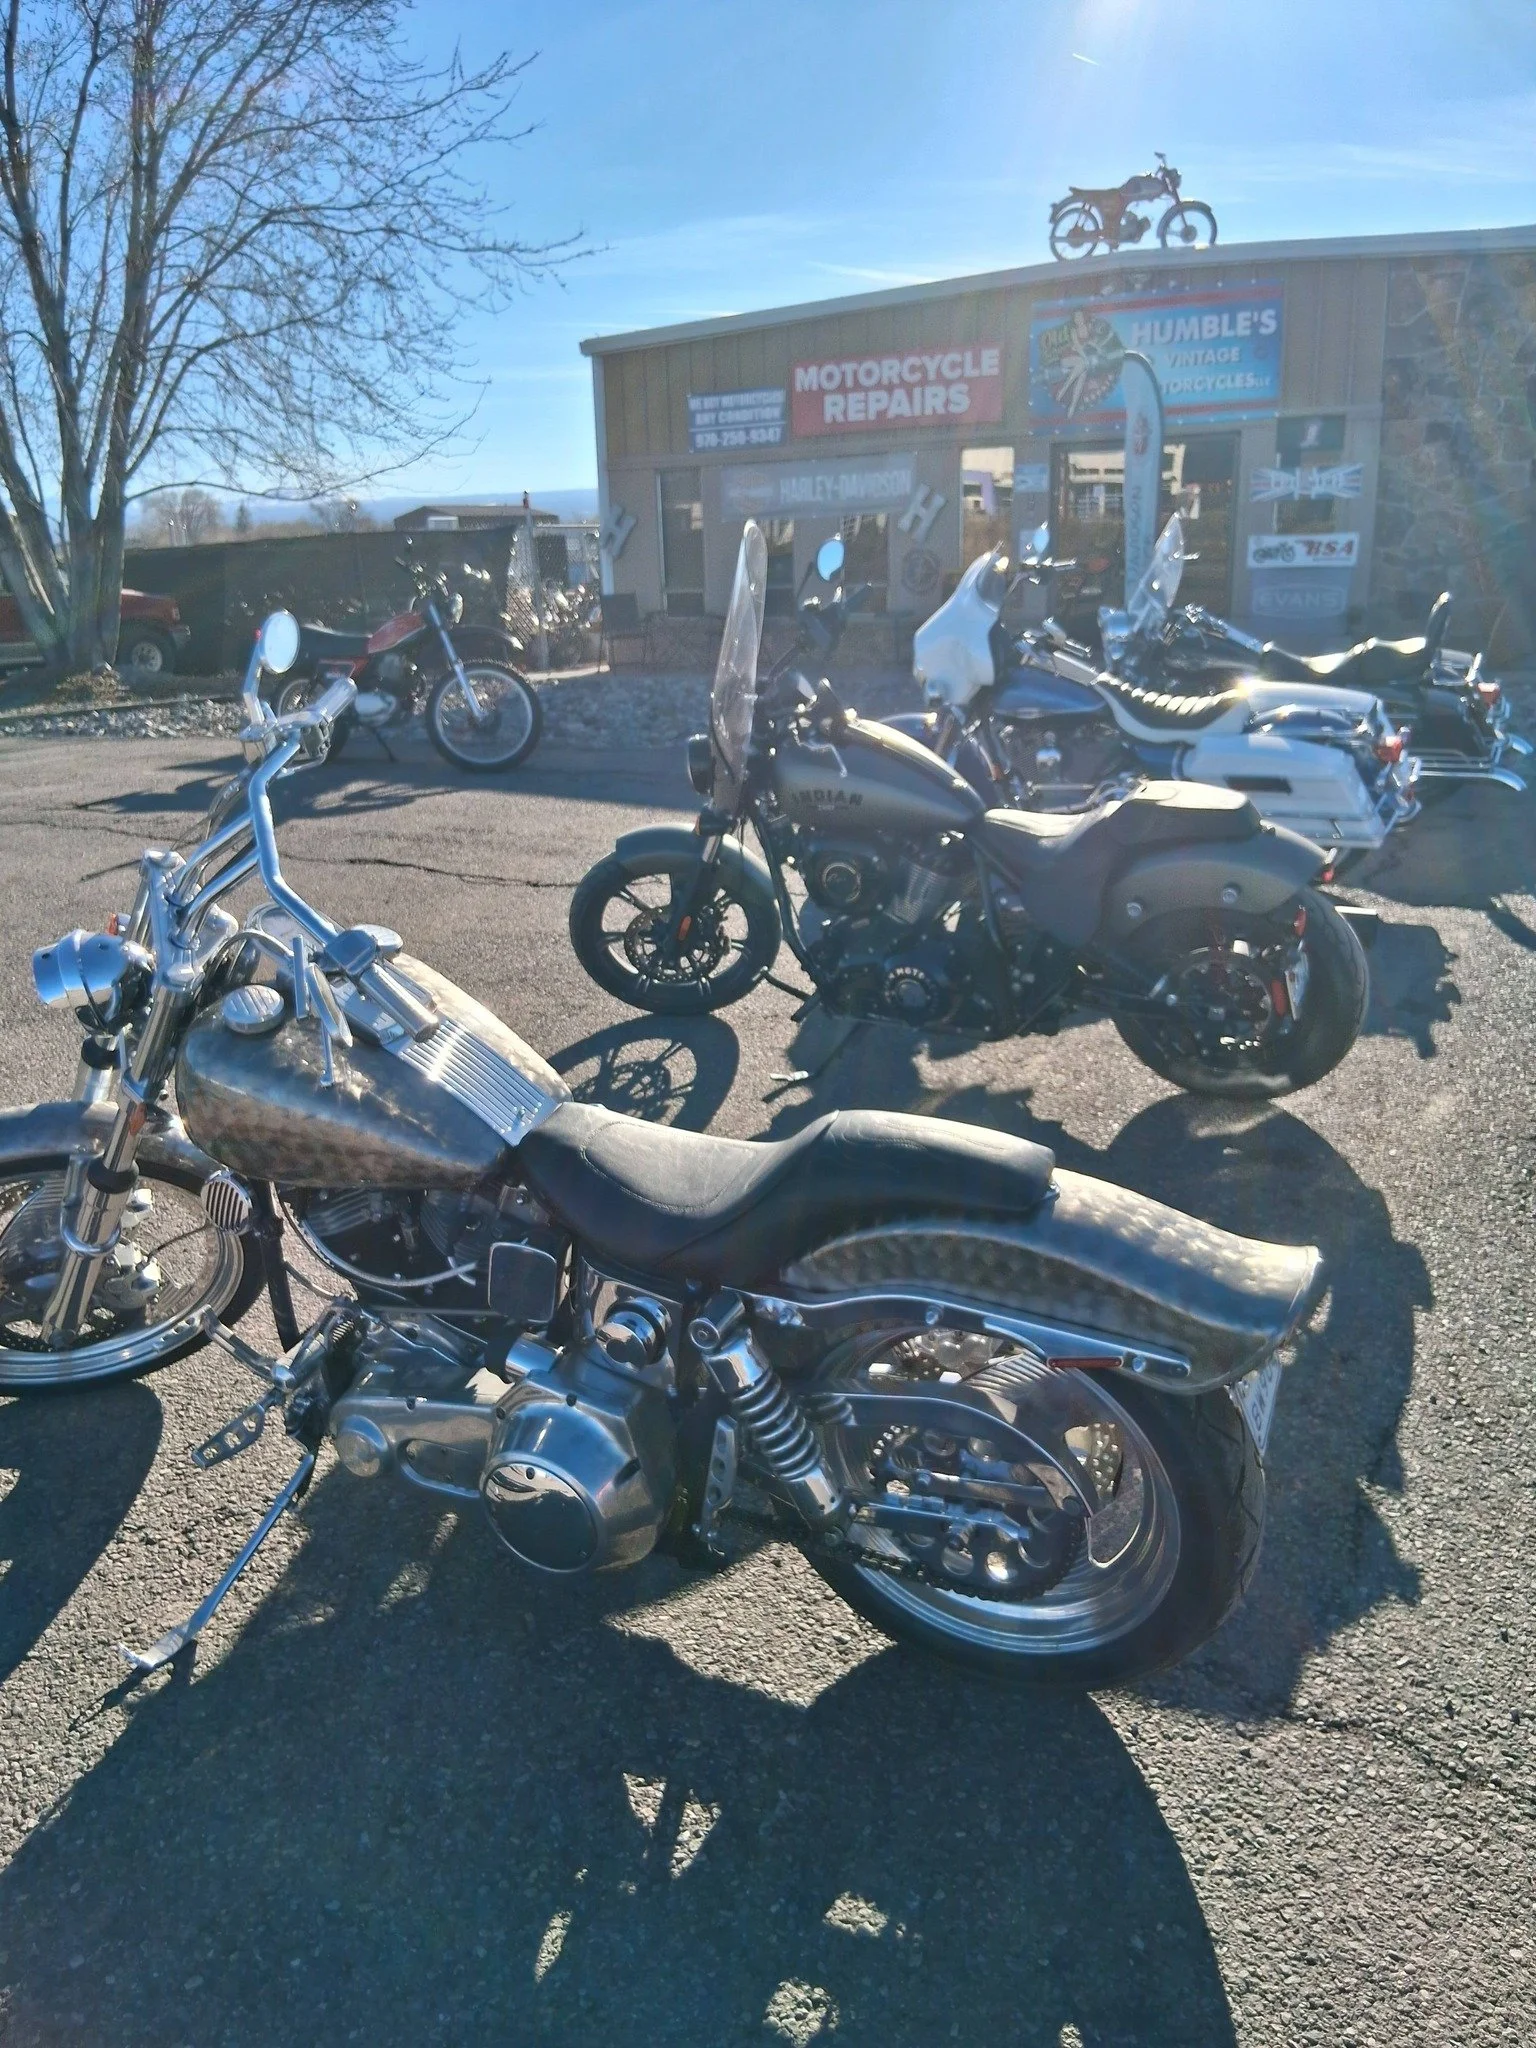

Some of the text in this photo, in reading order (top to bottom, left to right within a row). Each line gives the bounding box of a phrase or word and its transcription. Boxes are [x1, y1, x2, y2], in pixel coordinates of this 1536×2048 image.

[1130, 308, 1278, 346] HUMBLE'S
[794, 348, 1000, 393] MOTORCYCLE
[1166, 346, 1241, 368] VINTAGE
[1161, 372, 1254, 394] TORCYCLES
[824, 384, 972, 424] REPAIRS
[779, 469, 913, 504] HARLEY-DAVIDSON
[1259, 591, 1338, 609] EVANS
